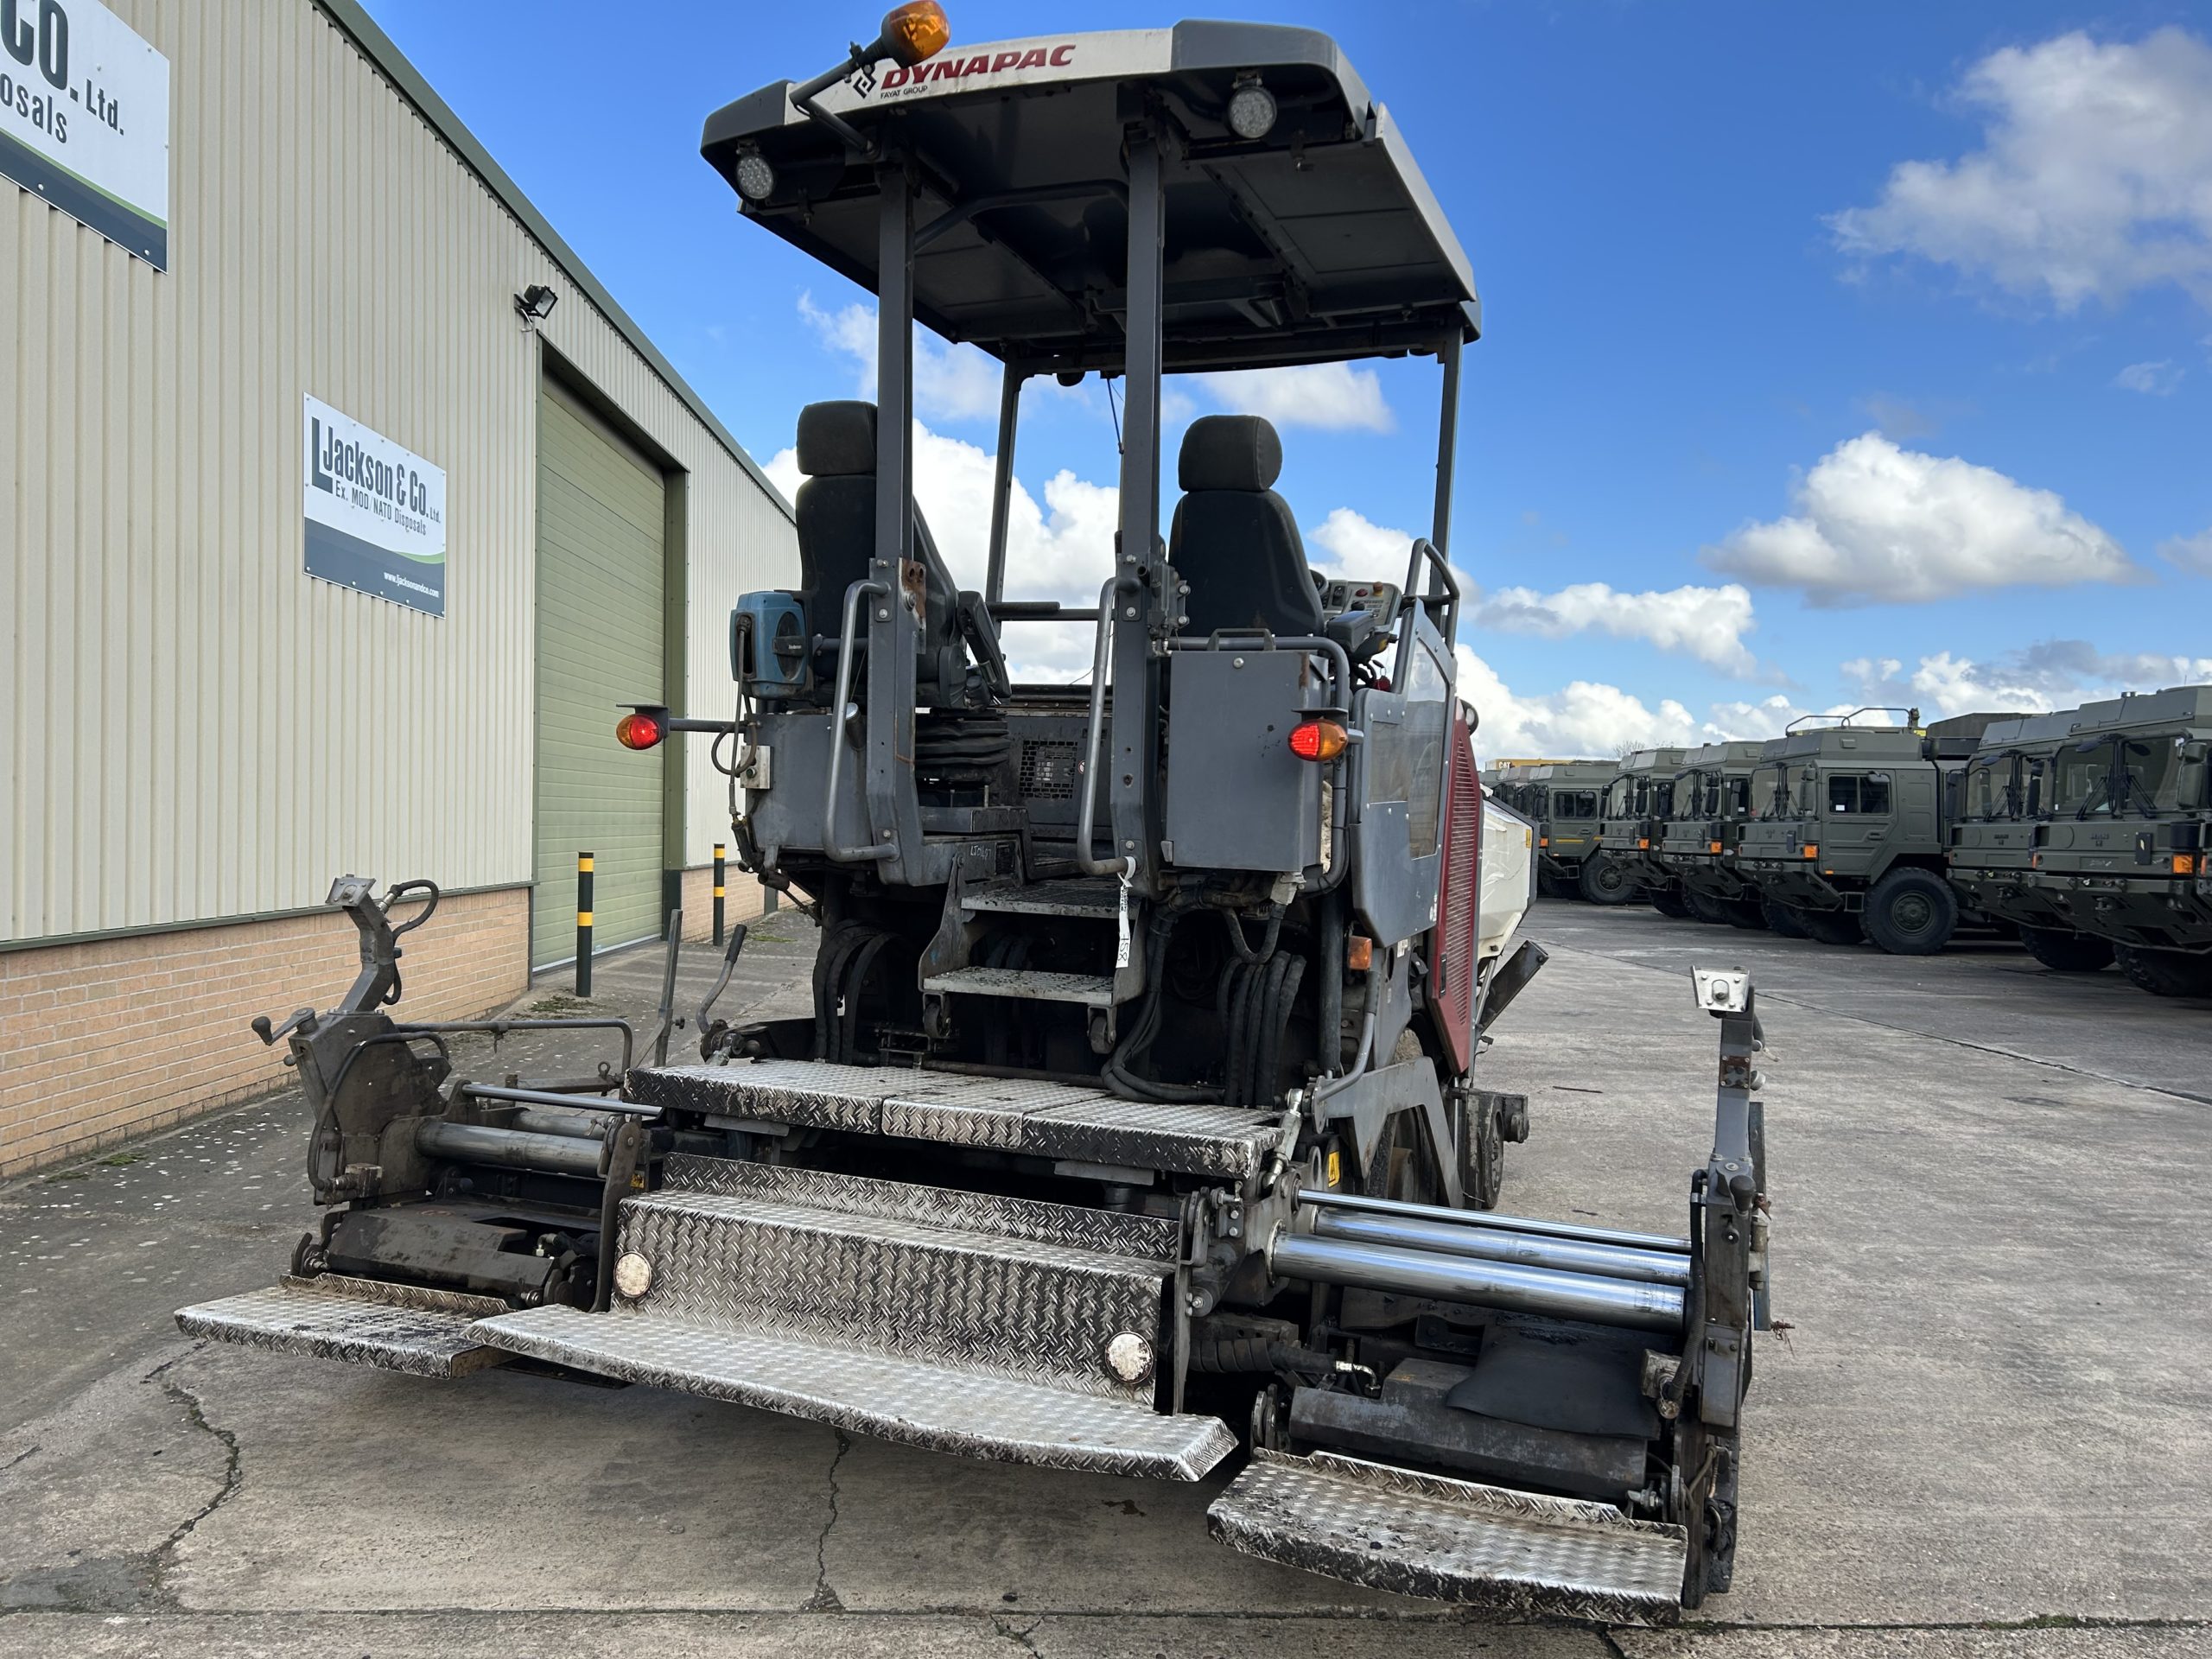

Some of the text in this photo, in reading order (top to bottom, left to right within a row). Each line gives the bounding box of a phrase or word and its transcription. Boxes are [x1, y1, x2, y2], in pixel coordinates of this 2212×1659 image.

[880, 44, 1077, 90] DYNAPAC
[880, 86, 928, 99] FAYAT GROUP
[86, 78, 124, 136] Ltd.
[335, 480, 427, 536] Ex. MOD/NATO Disposals
[396, 463, 407, 506] &
[429, 506, 442, 524] Ltd.
